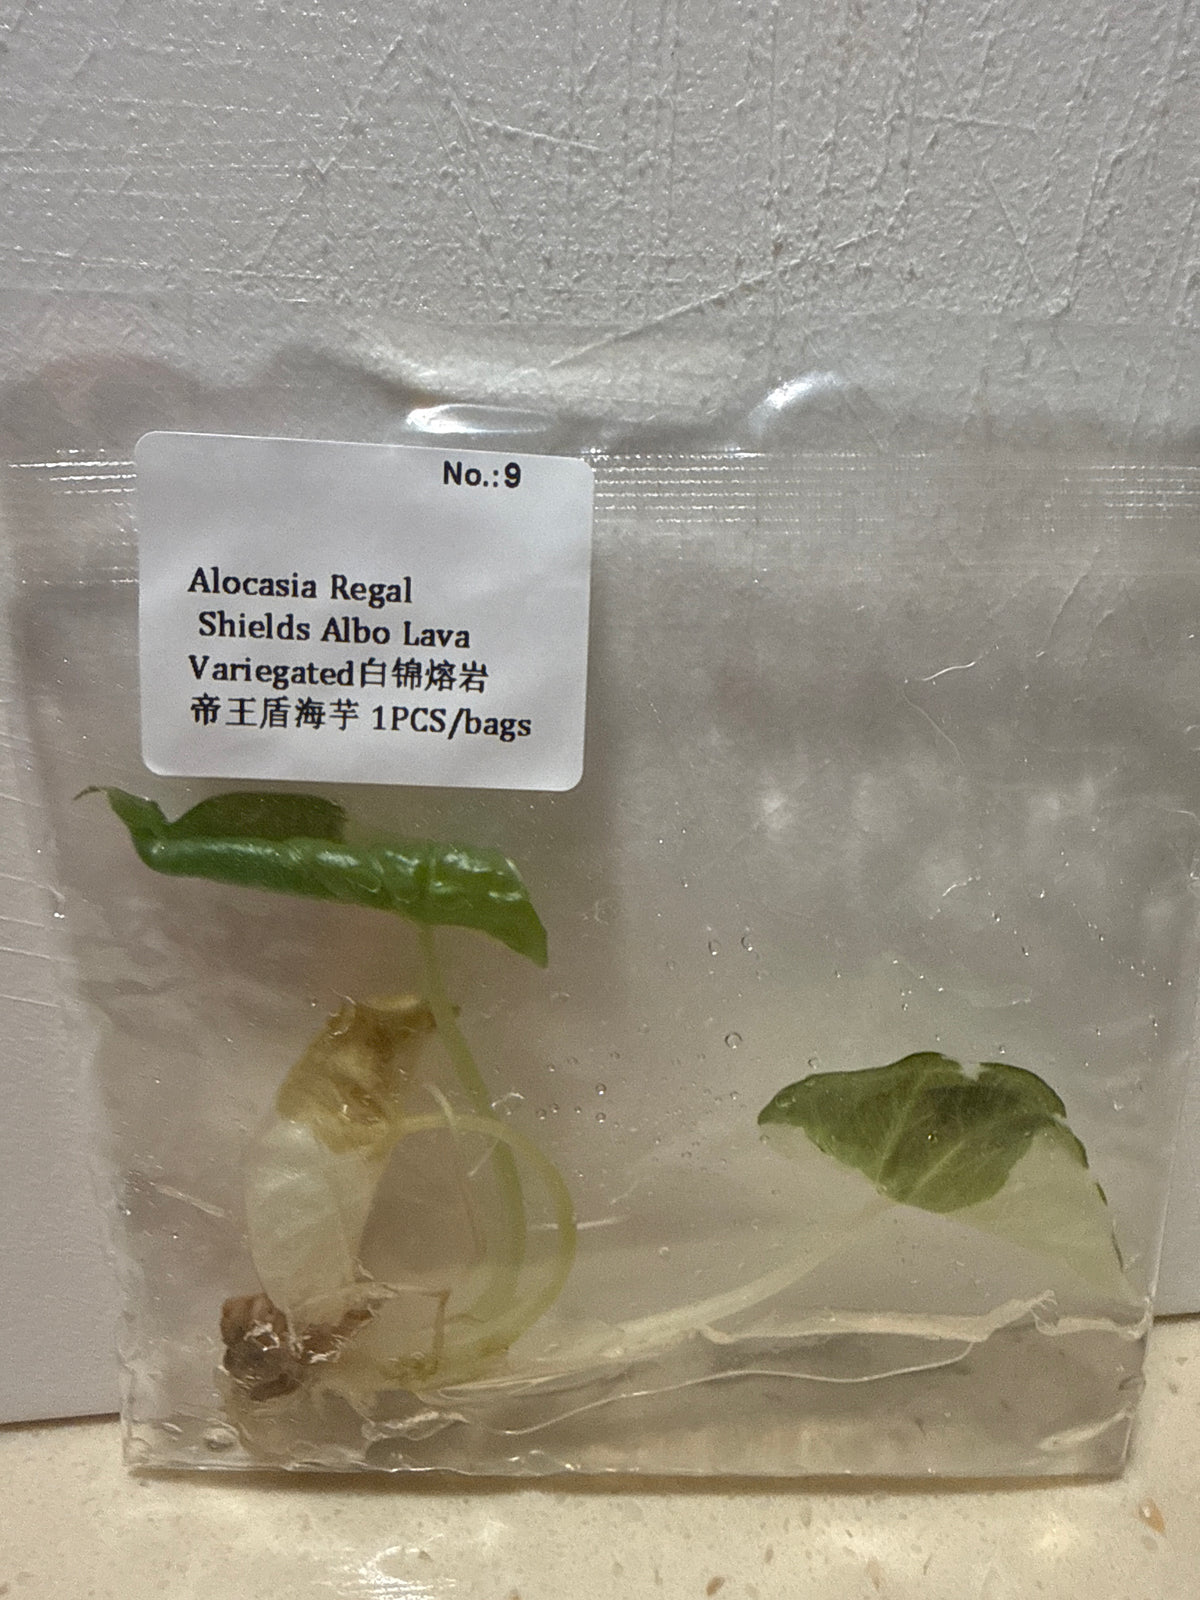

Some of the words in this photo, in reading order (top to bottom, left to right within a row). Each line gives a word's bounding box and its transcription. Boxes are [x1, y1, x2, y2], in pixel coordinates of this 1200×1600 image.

[443, 460, 521, 489] No.:9
[187, 566, 317, 599] Alocasia
[330, 573, 412, 609] Regal
[198, 609, 311, 641] Shields
[320, 615, 391, 645] Albo
[403, 620, 470, 649] Lava
[190, 693, 359, 731] 帝王盾海芋
[372, 705, 532, 743] 1PCS/bags
